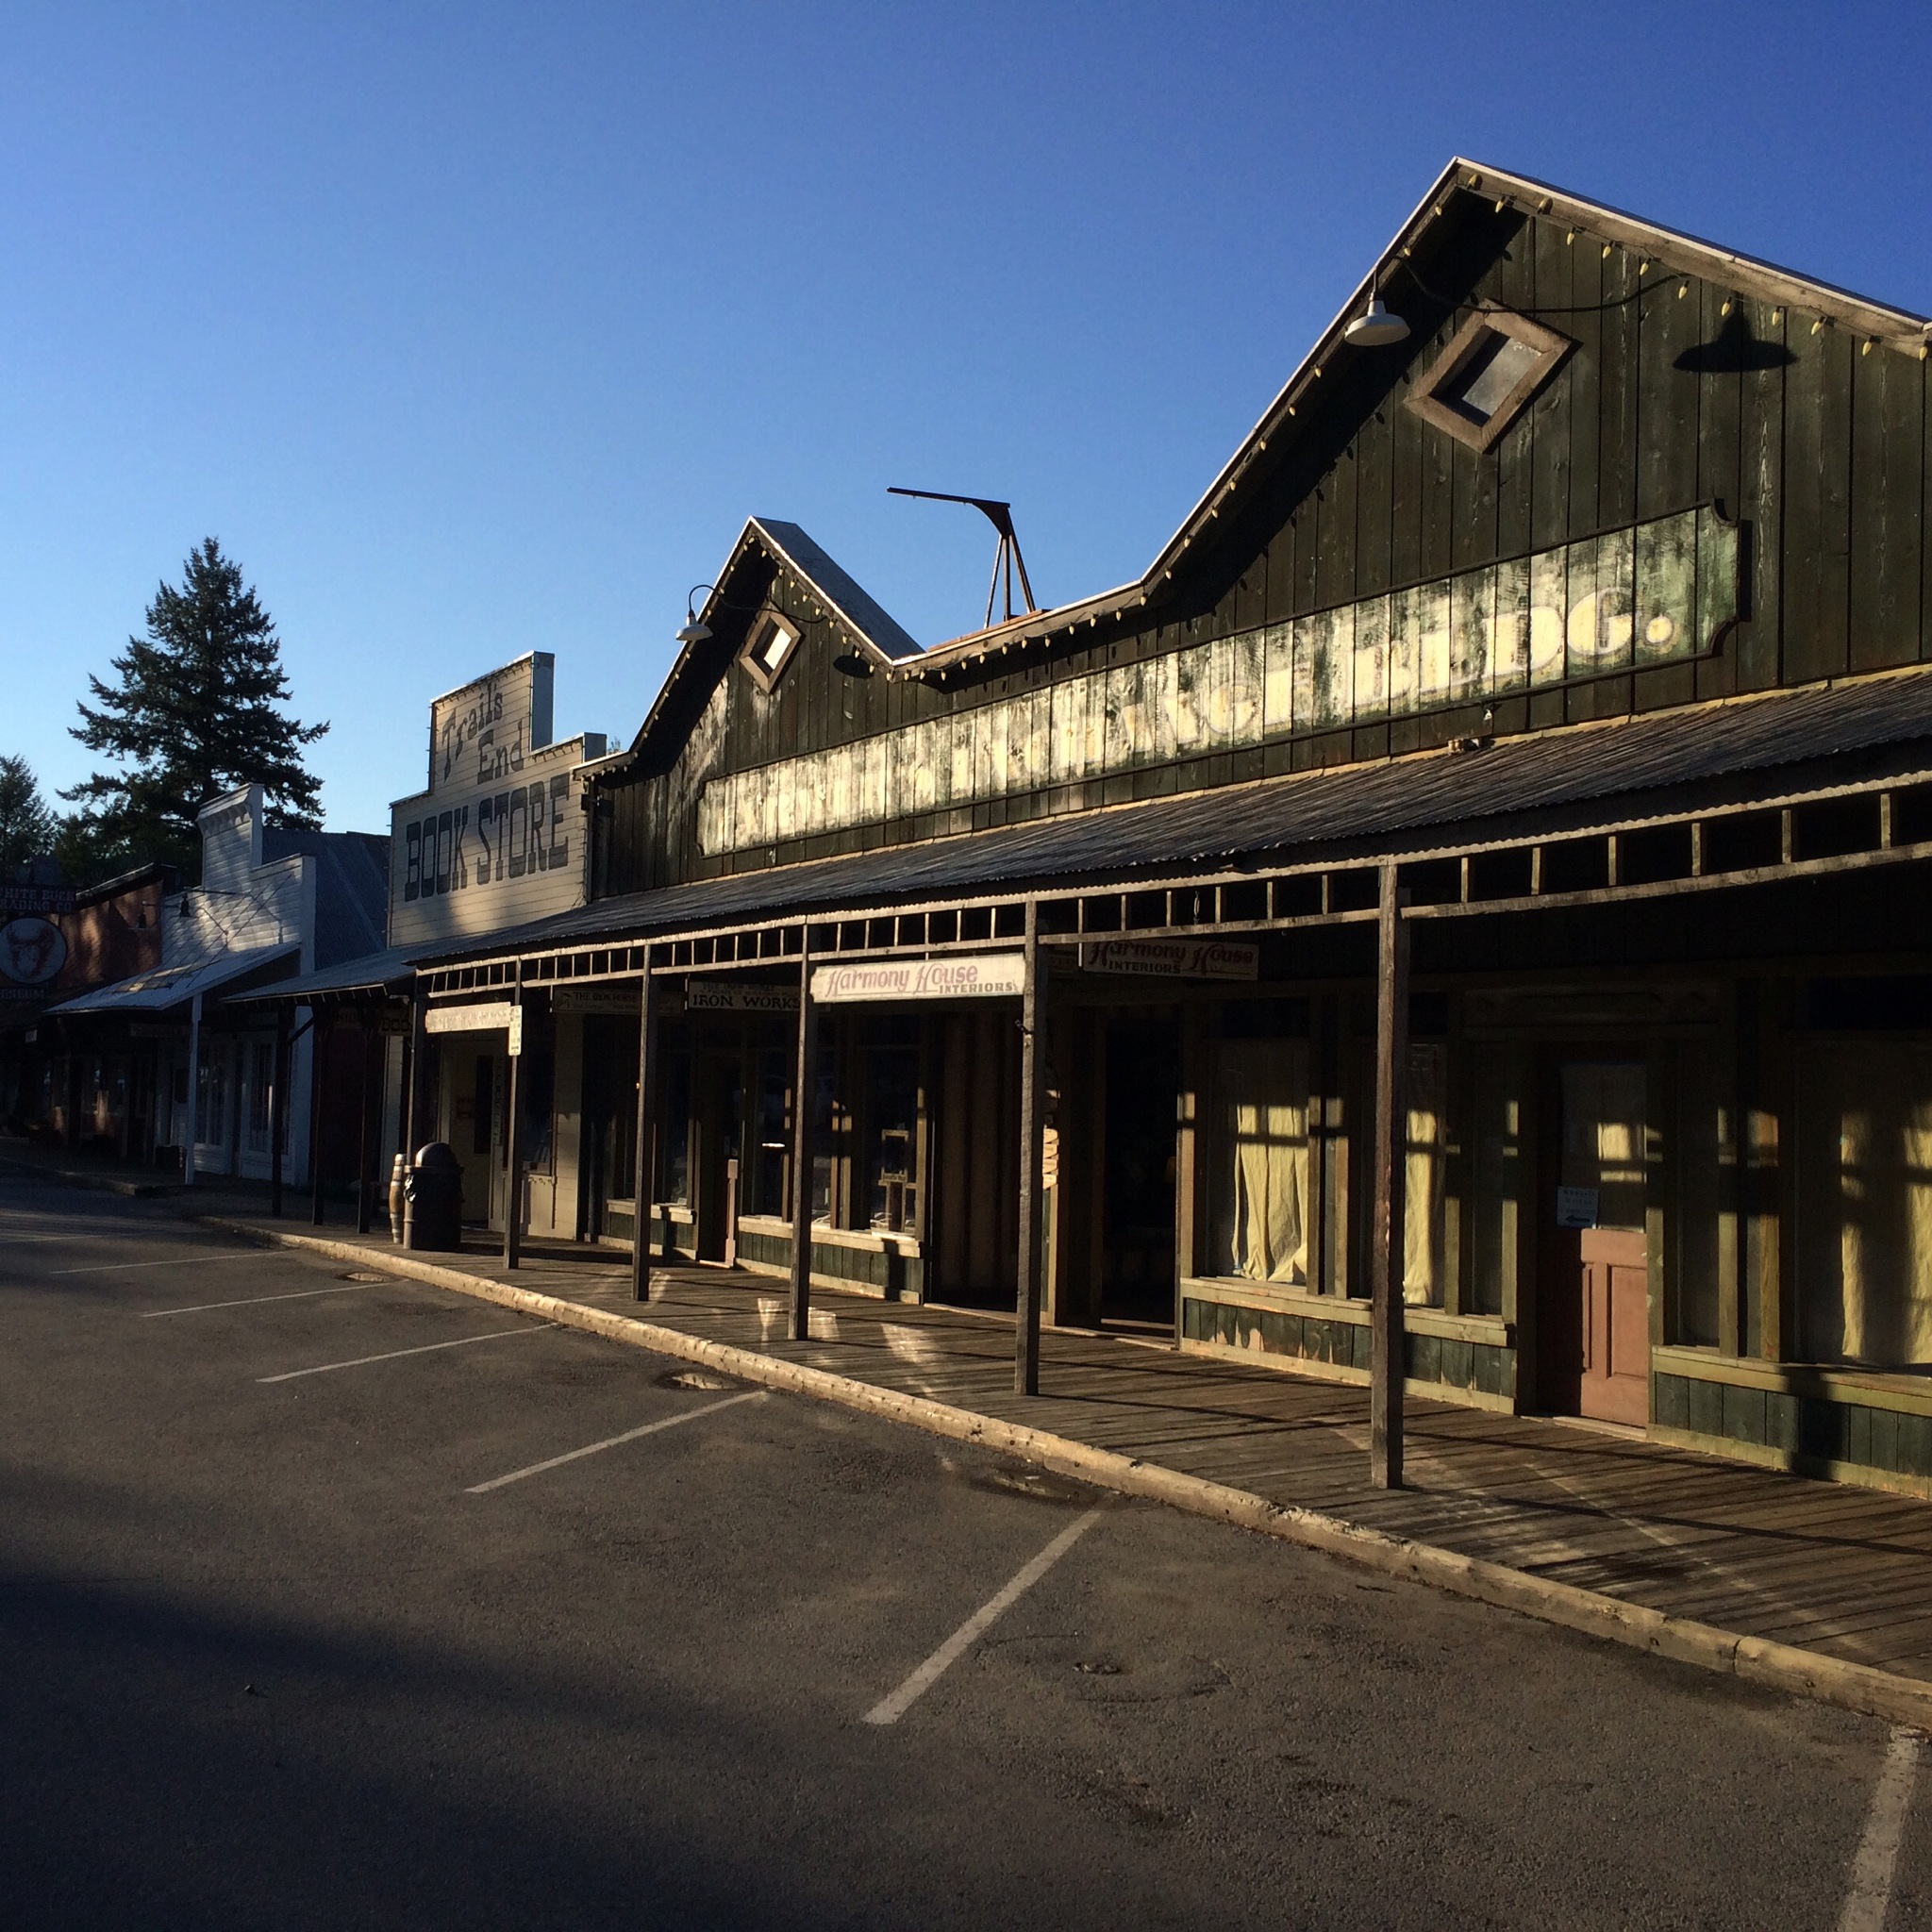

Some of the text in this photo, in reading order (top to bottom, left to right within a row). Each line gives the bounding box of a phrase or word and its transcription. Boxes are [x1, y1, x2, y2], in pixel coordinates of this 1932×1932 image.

[441, 682, 503, 783] Trail's
[477, 720, 525, 785] End
[405, 773, 570, 902] BOOK STORE
[1089, 941, 1186, 966] Harmony
[1191, 943, 1254, 974] House
[1108, 960, 1181, 974] INTERIORS
[825, 963, 978, 998] Harmony House
[939, 981, 1013, 994] INTERIORS
[693, 993, 734, 1008] IRON
[742, 995, 801, 1009] WORKS
